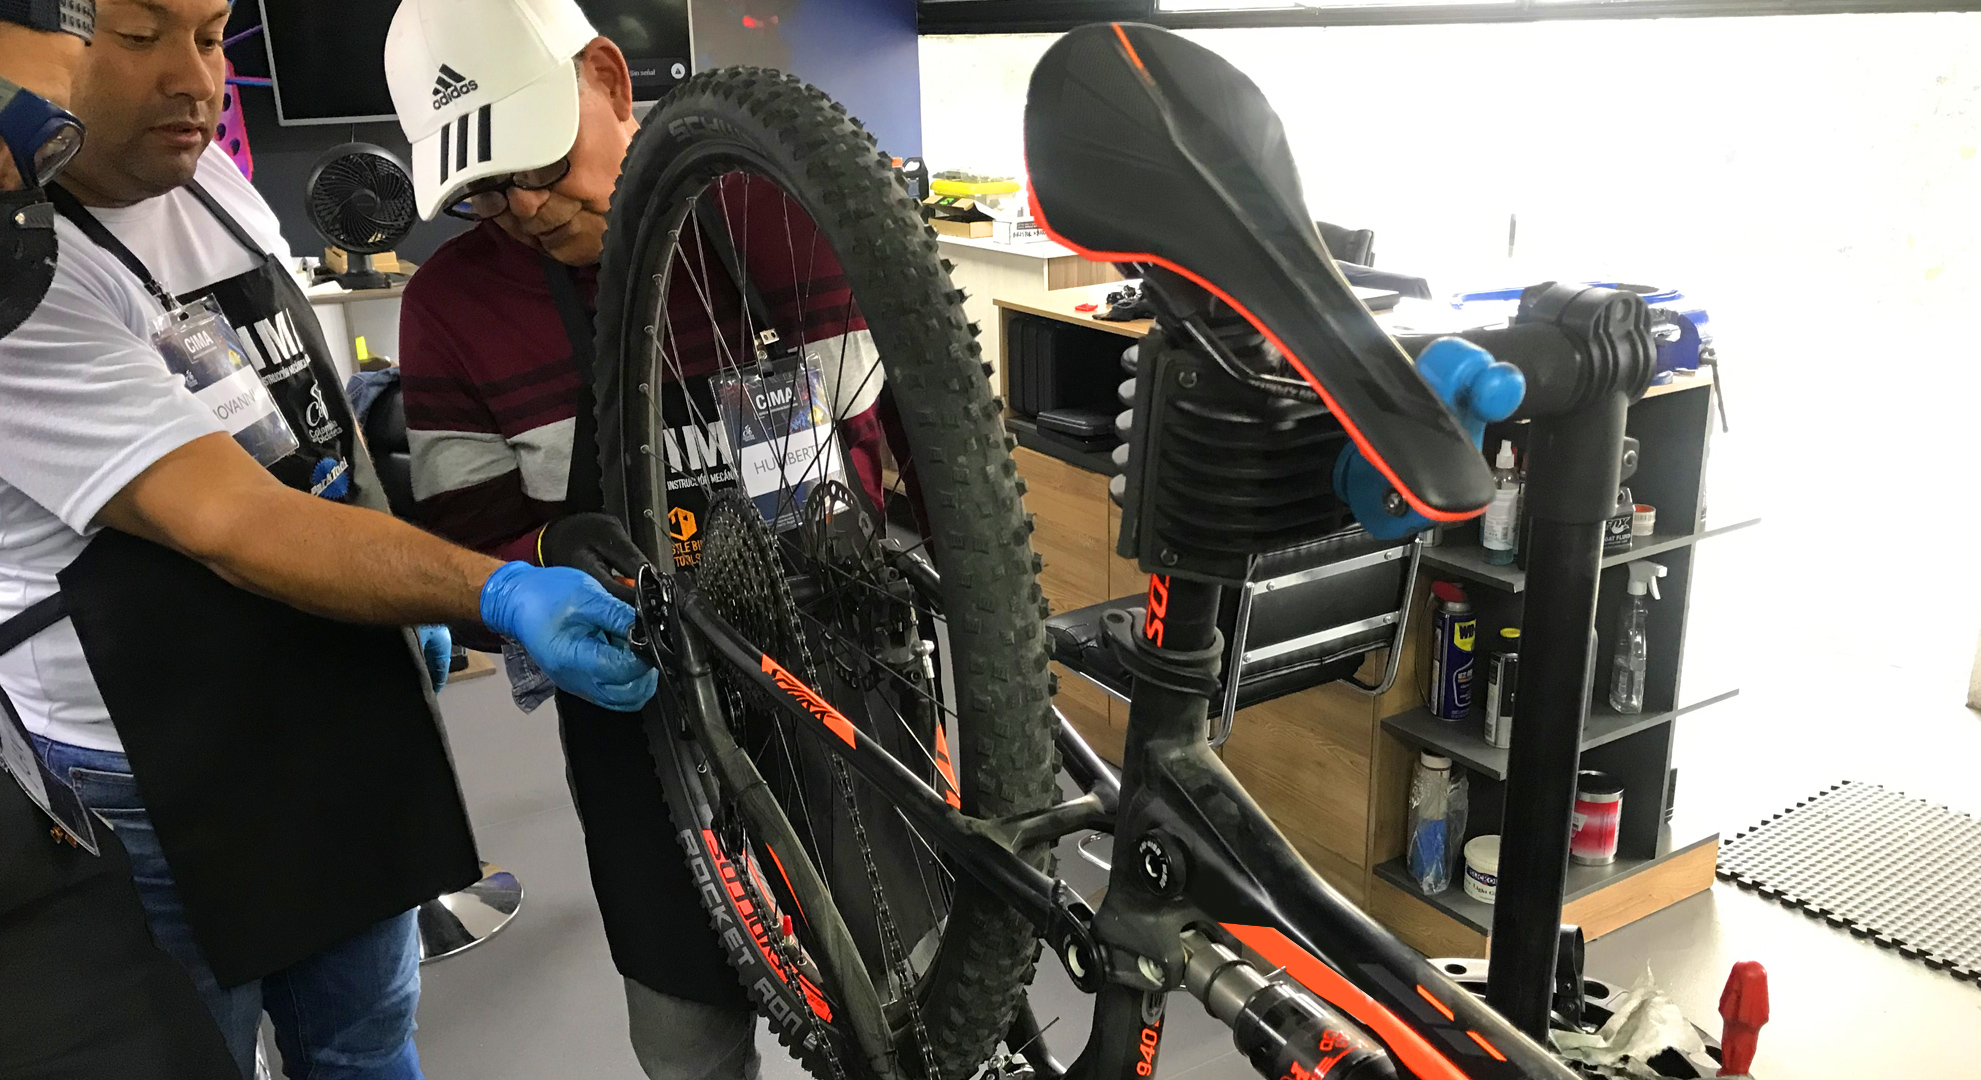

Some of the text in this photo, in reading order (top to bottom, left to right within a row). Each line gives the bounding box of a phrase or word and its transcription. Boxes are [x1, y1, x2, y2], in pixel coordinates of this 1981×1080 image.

[433, 79, 478, 110] adidas
[184, 330, 214, 353] CIMA
[755, 387, 796, 410] CIMA
[680, 829, 803, 1036] ROCKET RON
[1136, 1028, 1158, 1077] 940
